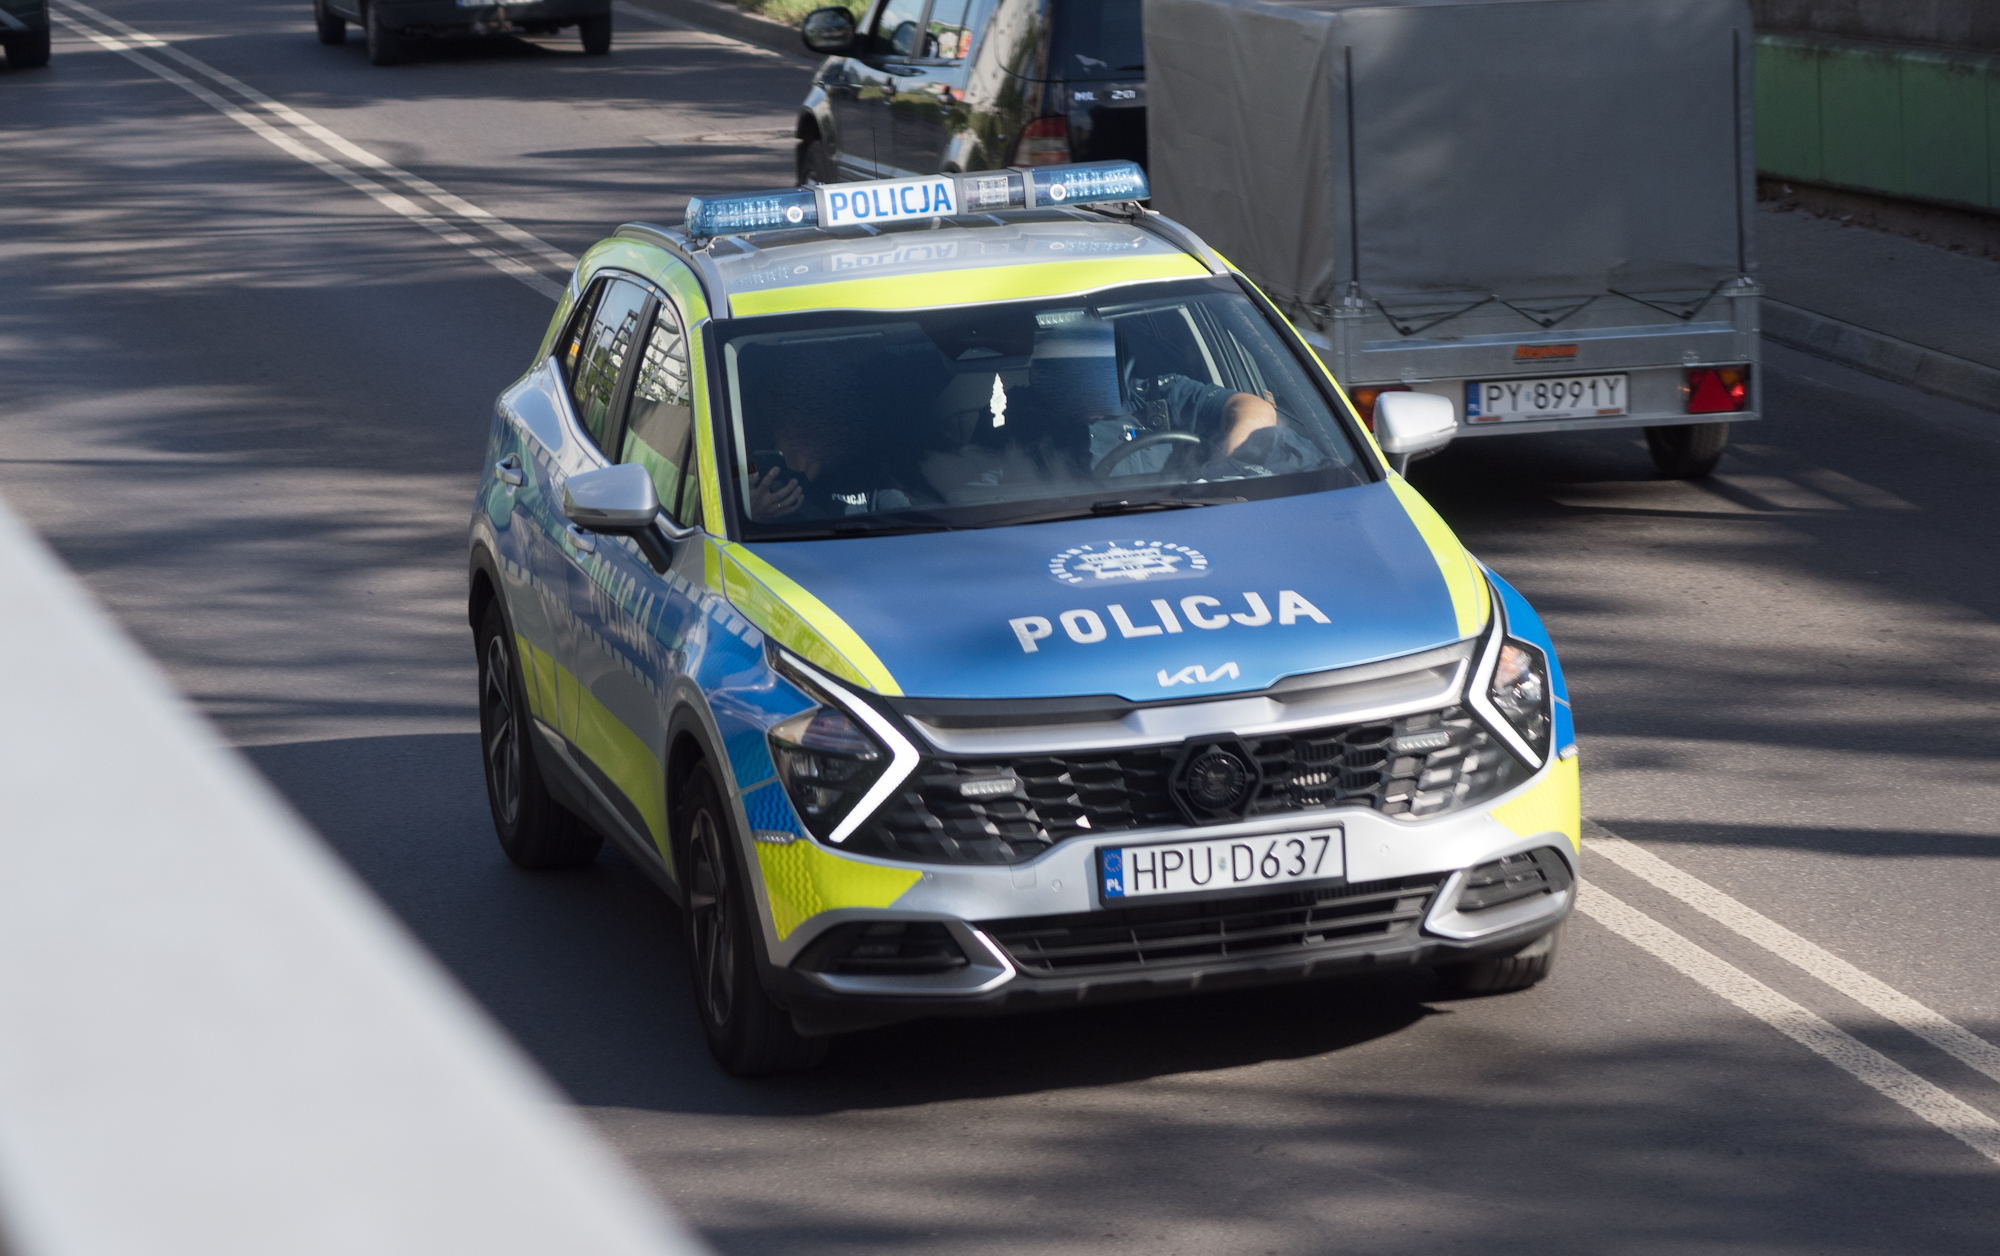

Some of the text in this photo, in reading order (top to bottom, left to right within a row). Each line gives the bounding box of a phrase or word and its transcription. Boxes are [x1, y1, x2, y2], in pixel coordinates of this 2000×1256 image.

[829, 183, 952, 221] POLICJA
[1486, 377, 1620, 412] PY 8991Y
[1008, 589, 1332, 654] POLICJA
[1156, 661, 1241, 688] KIA
[1131, 834, 1331, 891] HPU D637
[1106, 877, 1123, 893] PL
